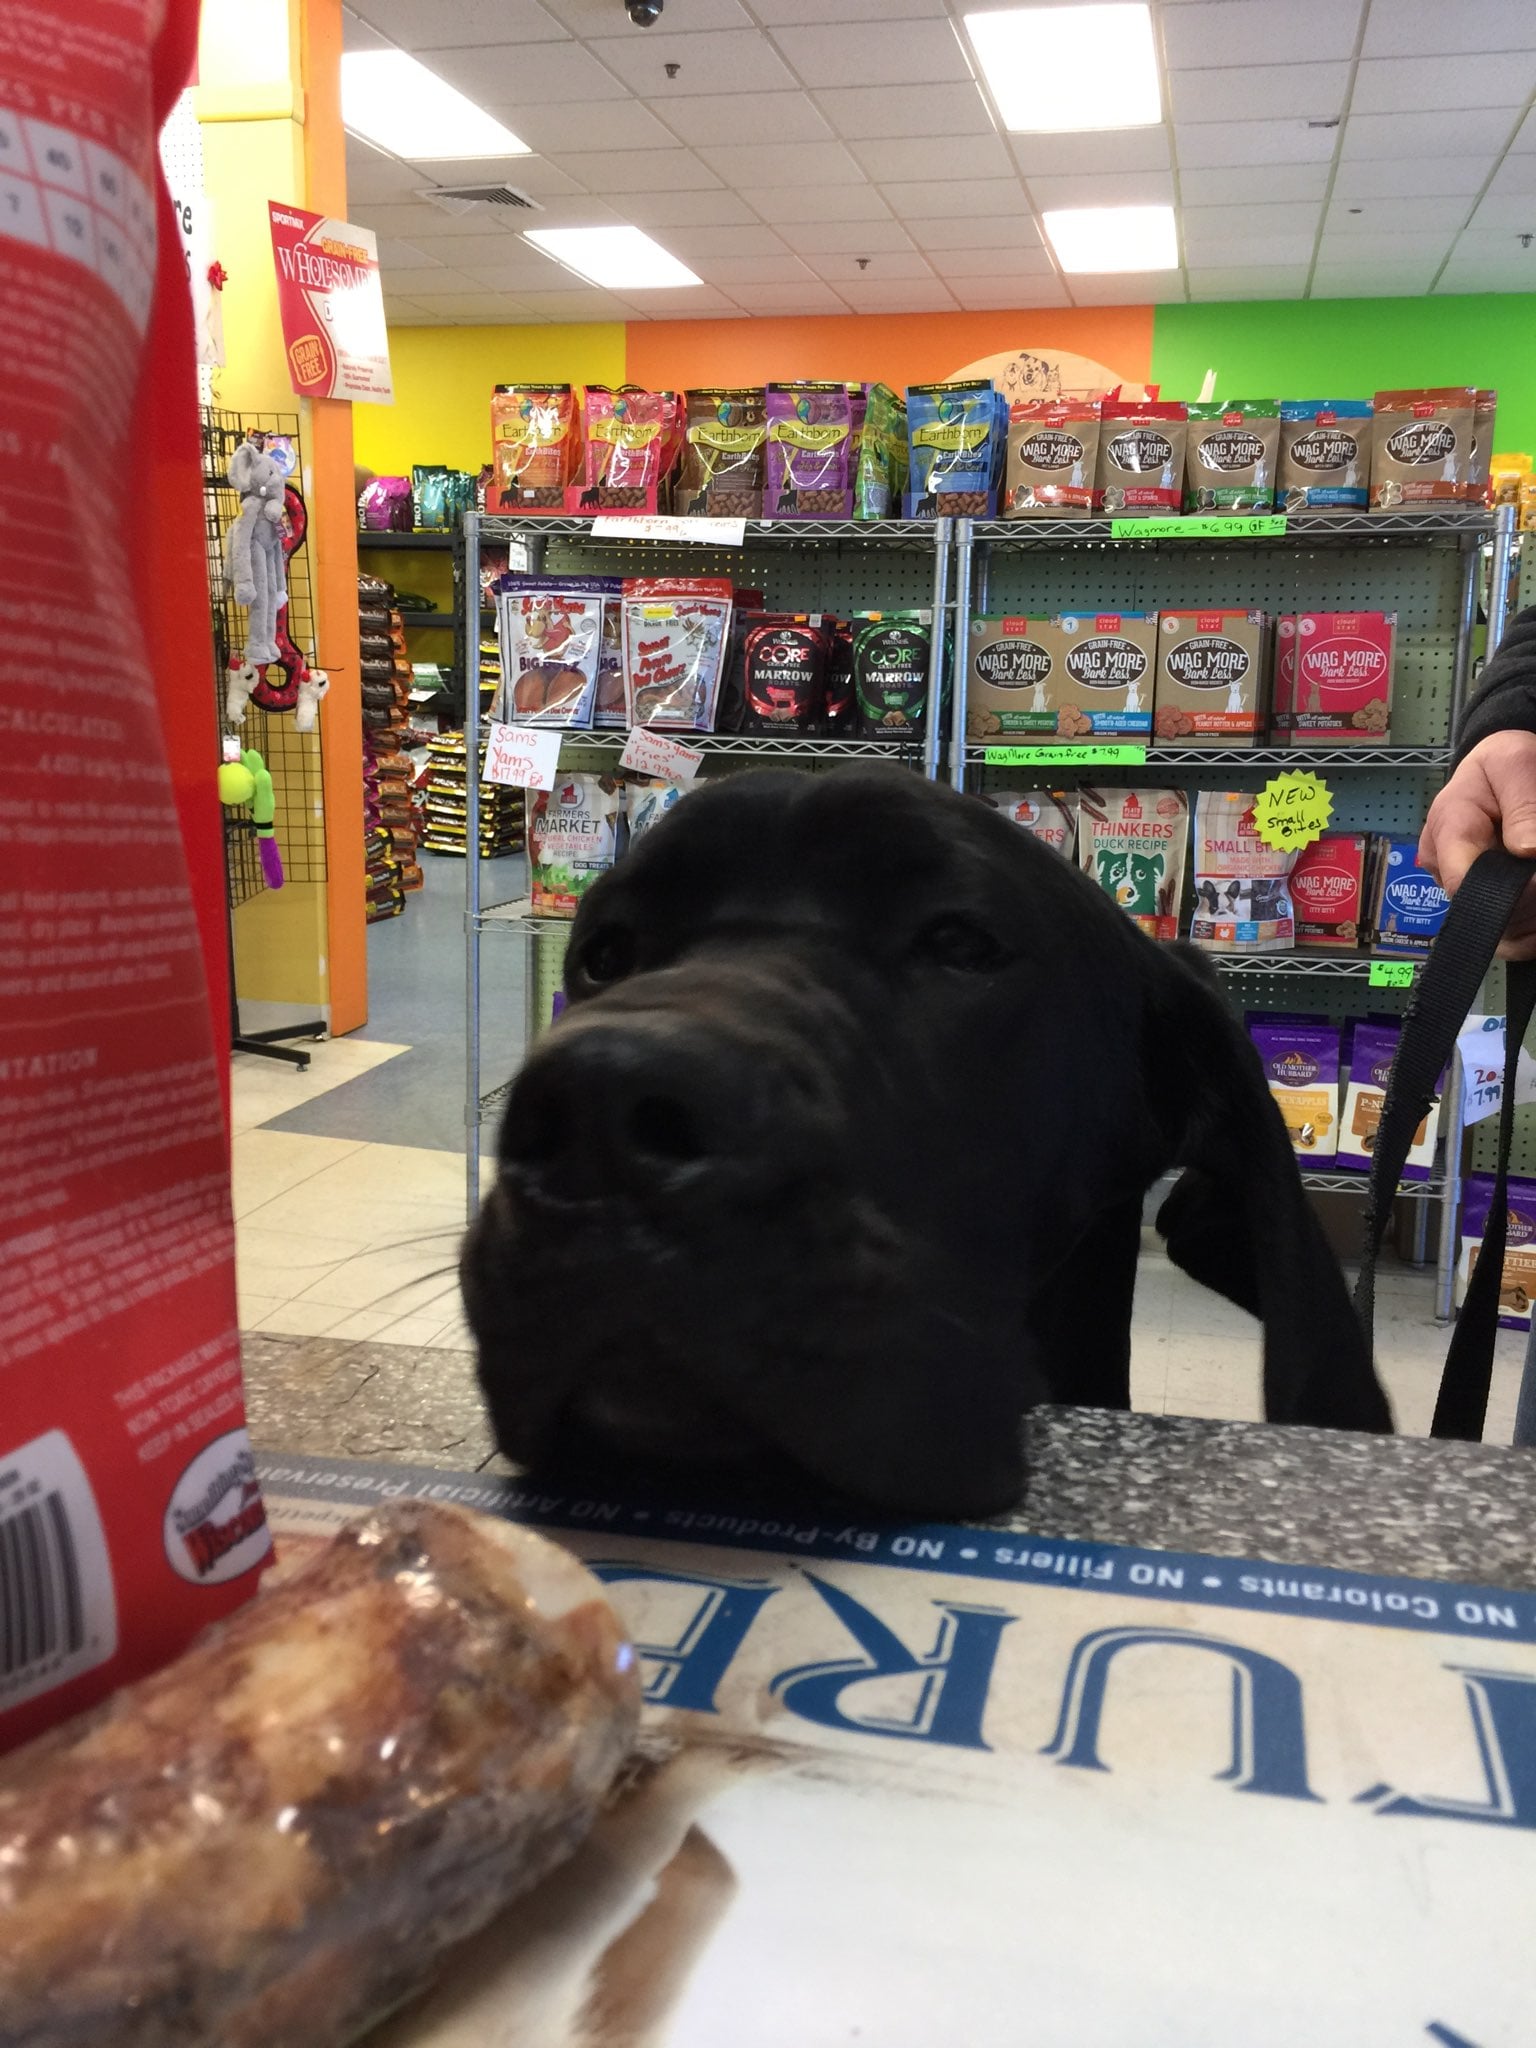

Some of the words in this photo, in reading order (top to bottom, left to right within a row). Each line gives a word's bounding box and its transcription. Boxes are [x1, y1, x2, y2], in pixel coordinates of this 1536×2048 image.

[294, 339, 320, 364] GRAIN
[300, 359, 322, 382] FREE
[697, 426, 761, 442] Earthborn
[777, 425, 841, 439] Earthborn
[920, 427, 981, 442] Earthborn
[1023, 442, 1047, 456] WAG
[1050, 443, 1081, 457] MORE
[1111, 442, 1136, 456] WAG
[1140, 442, 1170, 457] MORE
[1201, 443, 1226, 455] WAG
[1231, 443, 1262, 455] MORE
[1293, 442, 1319, 457] WAG
[1324, 441, 1355, 456] MORE
[1390, 435, 1417, 450] WAG
[1421, 434, 1453, 448] MORE
[1119, 525, 1185, 538] Wagmore
[996, 641, 1032, 652] GRAIN-FREE
[1088, 640, 1127, 650] GRAIN-FREE
[1189, 640, 1229, 650] GRAIN-FREE
[759, 645, 809, 663] CORE
[870, 647, 920, 666] CORE
[1069, 652, 1100, 670] WAG
[1105, 652, 1144, 670] MORE
[1170, 652, 1201, 670] WAG
[1207, 652, 1247, 670] MORE
[1306, 651, 1338, 669] WAG
[1343, 651, 1383, 668] MORE
[520, 657, 539, 671] BIG
[978, 653, 1008, 671] WAG
[1012, 653, 1049, 671] MORE
[754, 669, 813, 682] MARROW
[865, 672, 925, 683] MARROW
[990, 668, 1015, 680] Bark
[1016, 668, 1036, 680] Less
[1081, 667, 1107, 679] Bark
[1108, 667, 1130, 679] Less
[1183, 667, 1209, 679] Bark
[1210, 667, 1232, 679] Less
[1320, 665, 1345, 677] Bark
[1347, 665, 1369, 677] Less
[496, 726, 538, 746] Sams
[640, 730, 670, 750] Sams
[493, 746, 533, 770] Yams
[1269, 786, 1315, 807] NEW
[548, 810, 590, 819] FARMERS
[535, 818, 600, 834] MARKET
[1092, 822, 1173, 838] THINKERS
[1094, 839, 1124, 849] DUCK
[1128, 840, 1167, 850] RECIPE
[1205, 840, 1250, 853] SMALL
[1295, 876, 1320, 889] WAG
[1323, 876, 1355, 890] MORE
[1390, 884, 1417, 897] WAG
[1400, 896, 1421, 906] Bark
[1272, 1062, 1286, 1070] OLD
[1288, 1064, 1317, 1072] MOTHER
[1277, 1069, 1312, 1078] HUBBARD
[667, 1508, 877, 1553] By-Products
[890, 1535, 946, 1561] NO
[994, 1547, 1115, 1581] Fillers
[1129, 1564, 1186, 1589] NO
[1240, 1574, 1440, 1619] Colorants
[1455, 1599, 1519, 1629] NO
